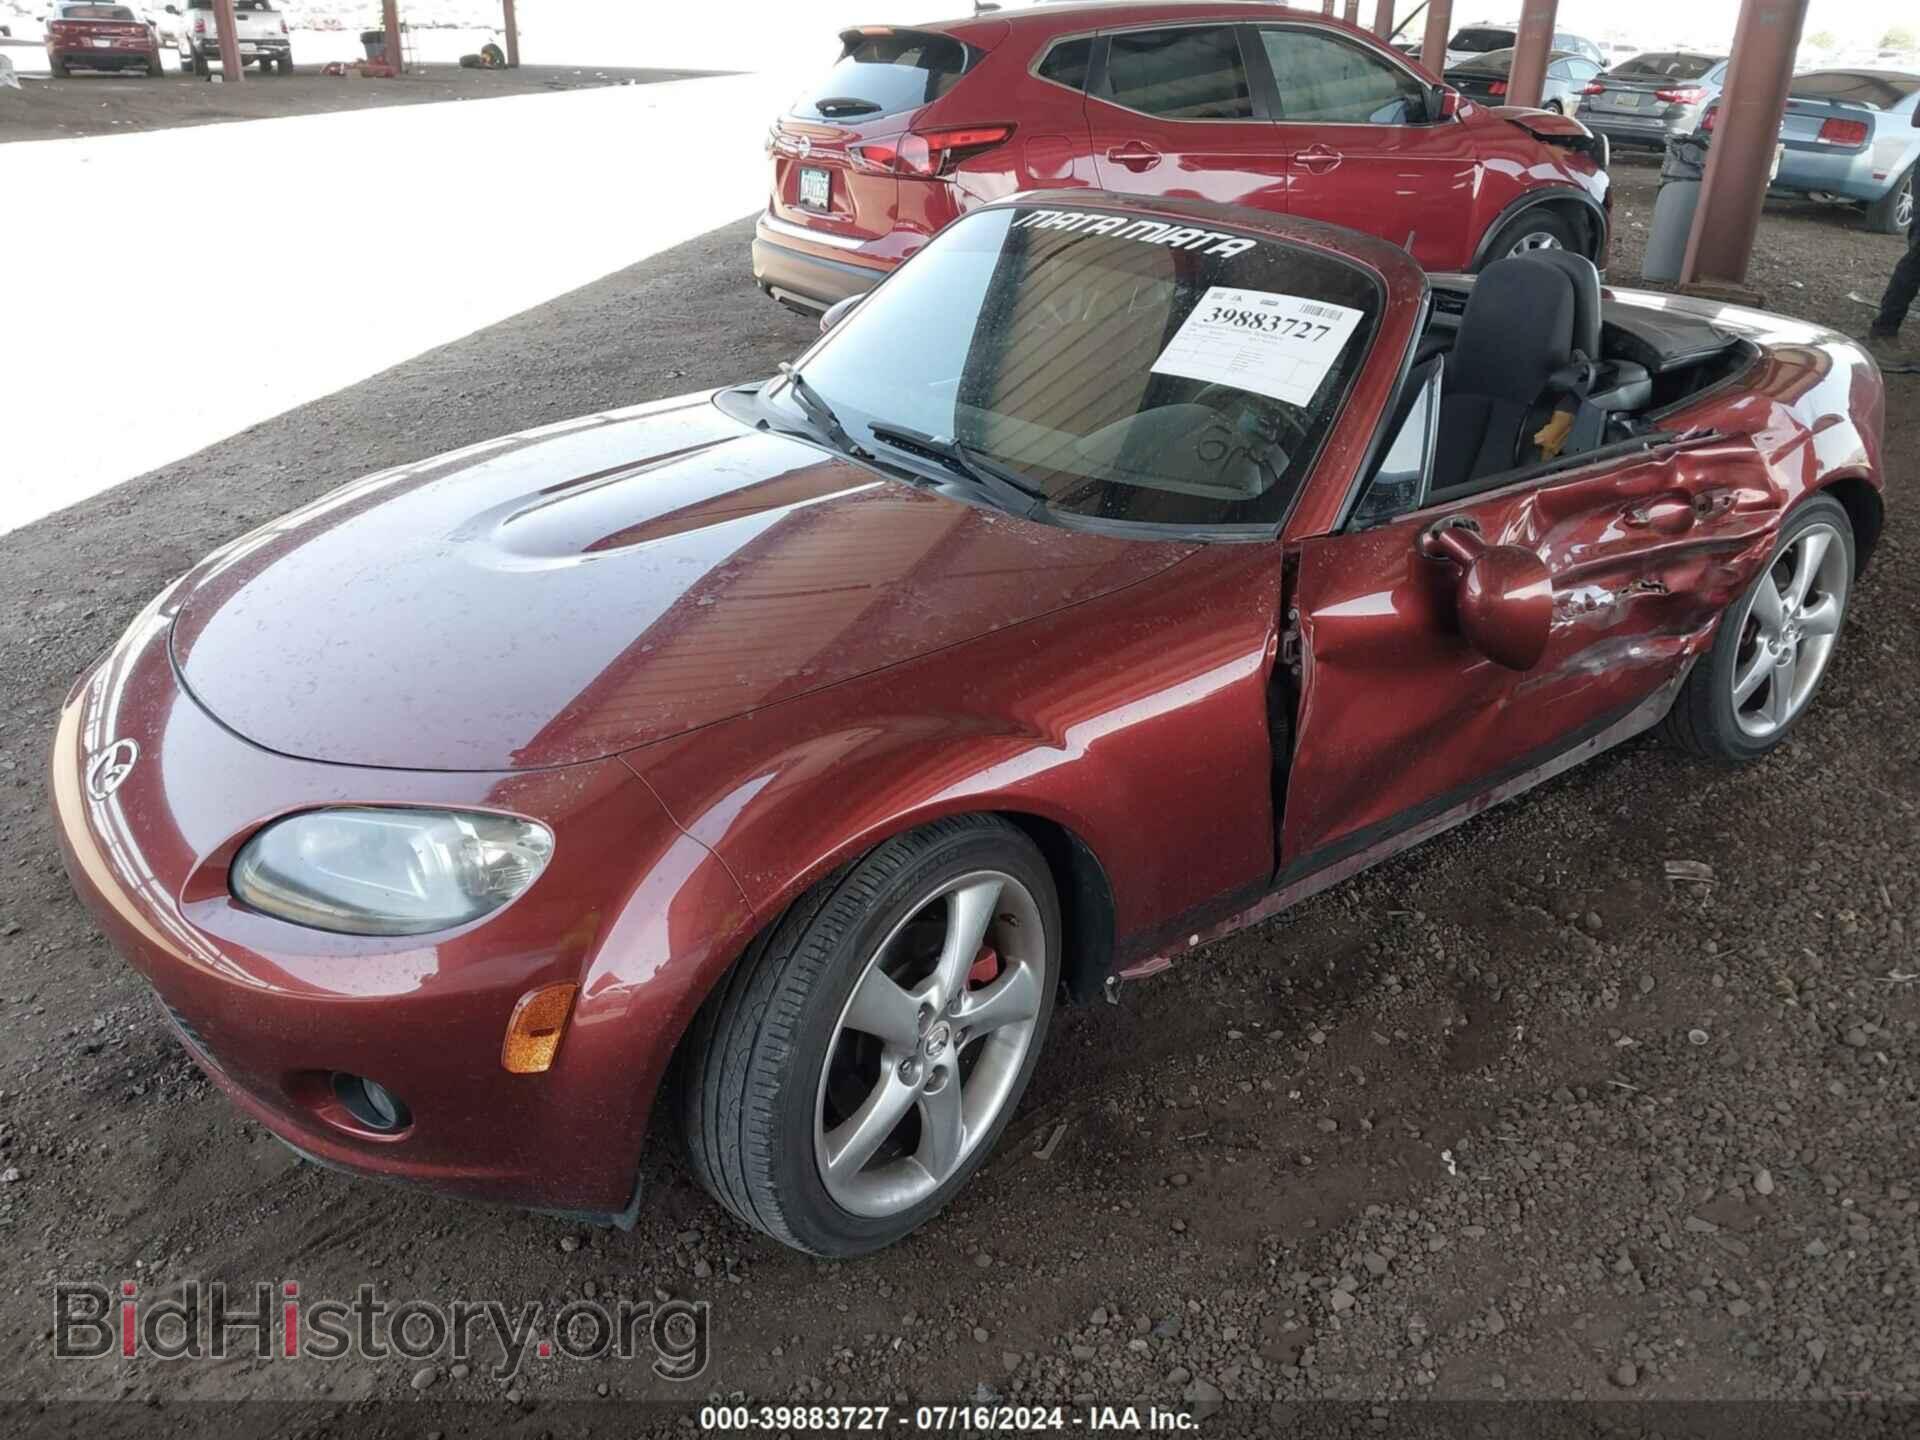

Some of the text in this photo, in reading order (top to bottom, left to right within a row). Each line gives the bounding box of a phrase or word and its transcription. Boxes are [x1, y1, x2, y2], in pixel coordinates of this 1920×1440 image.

[1011, 209, 1258, 258] MATA MIATA
[1203, 306, 1332, 342] 39883727
